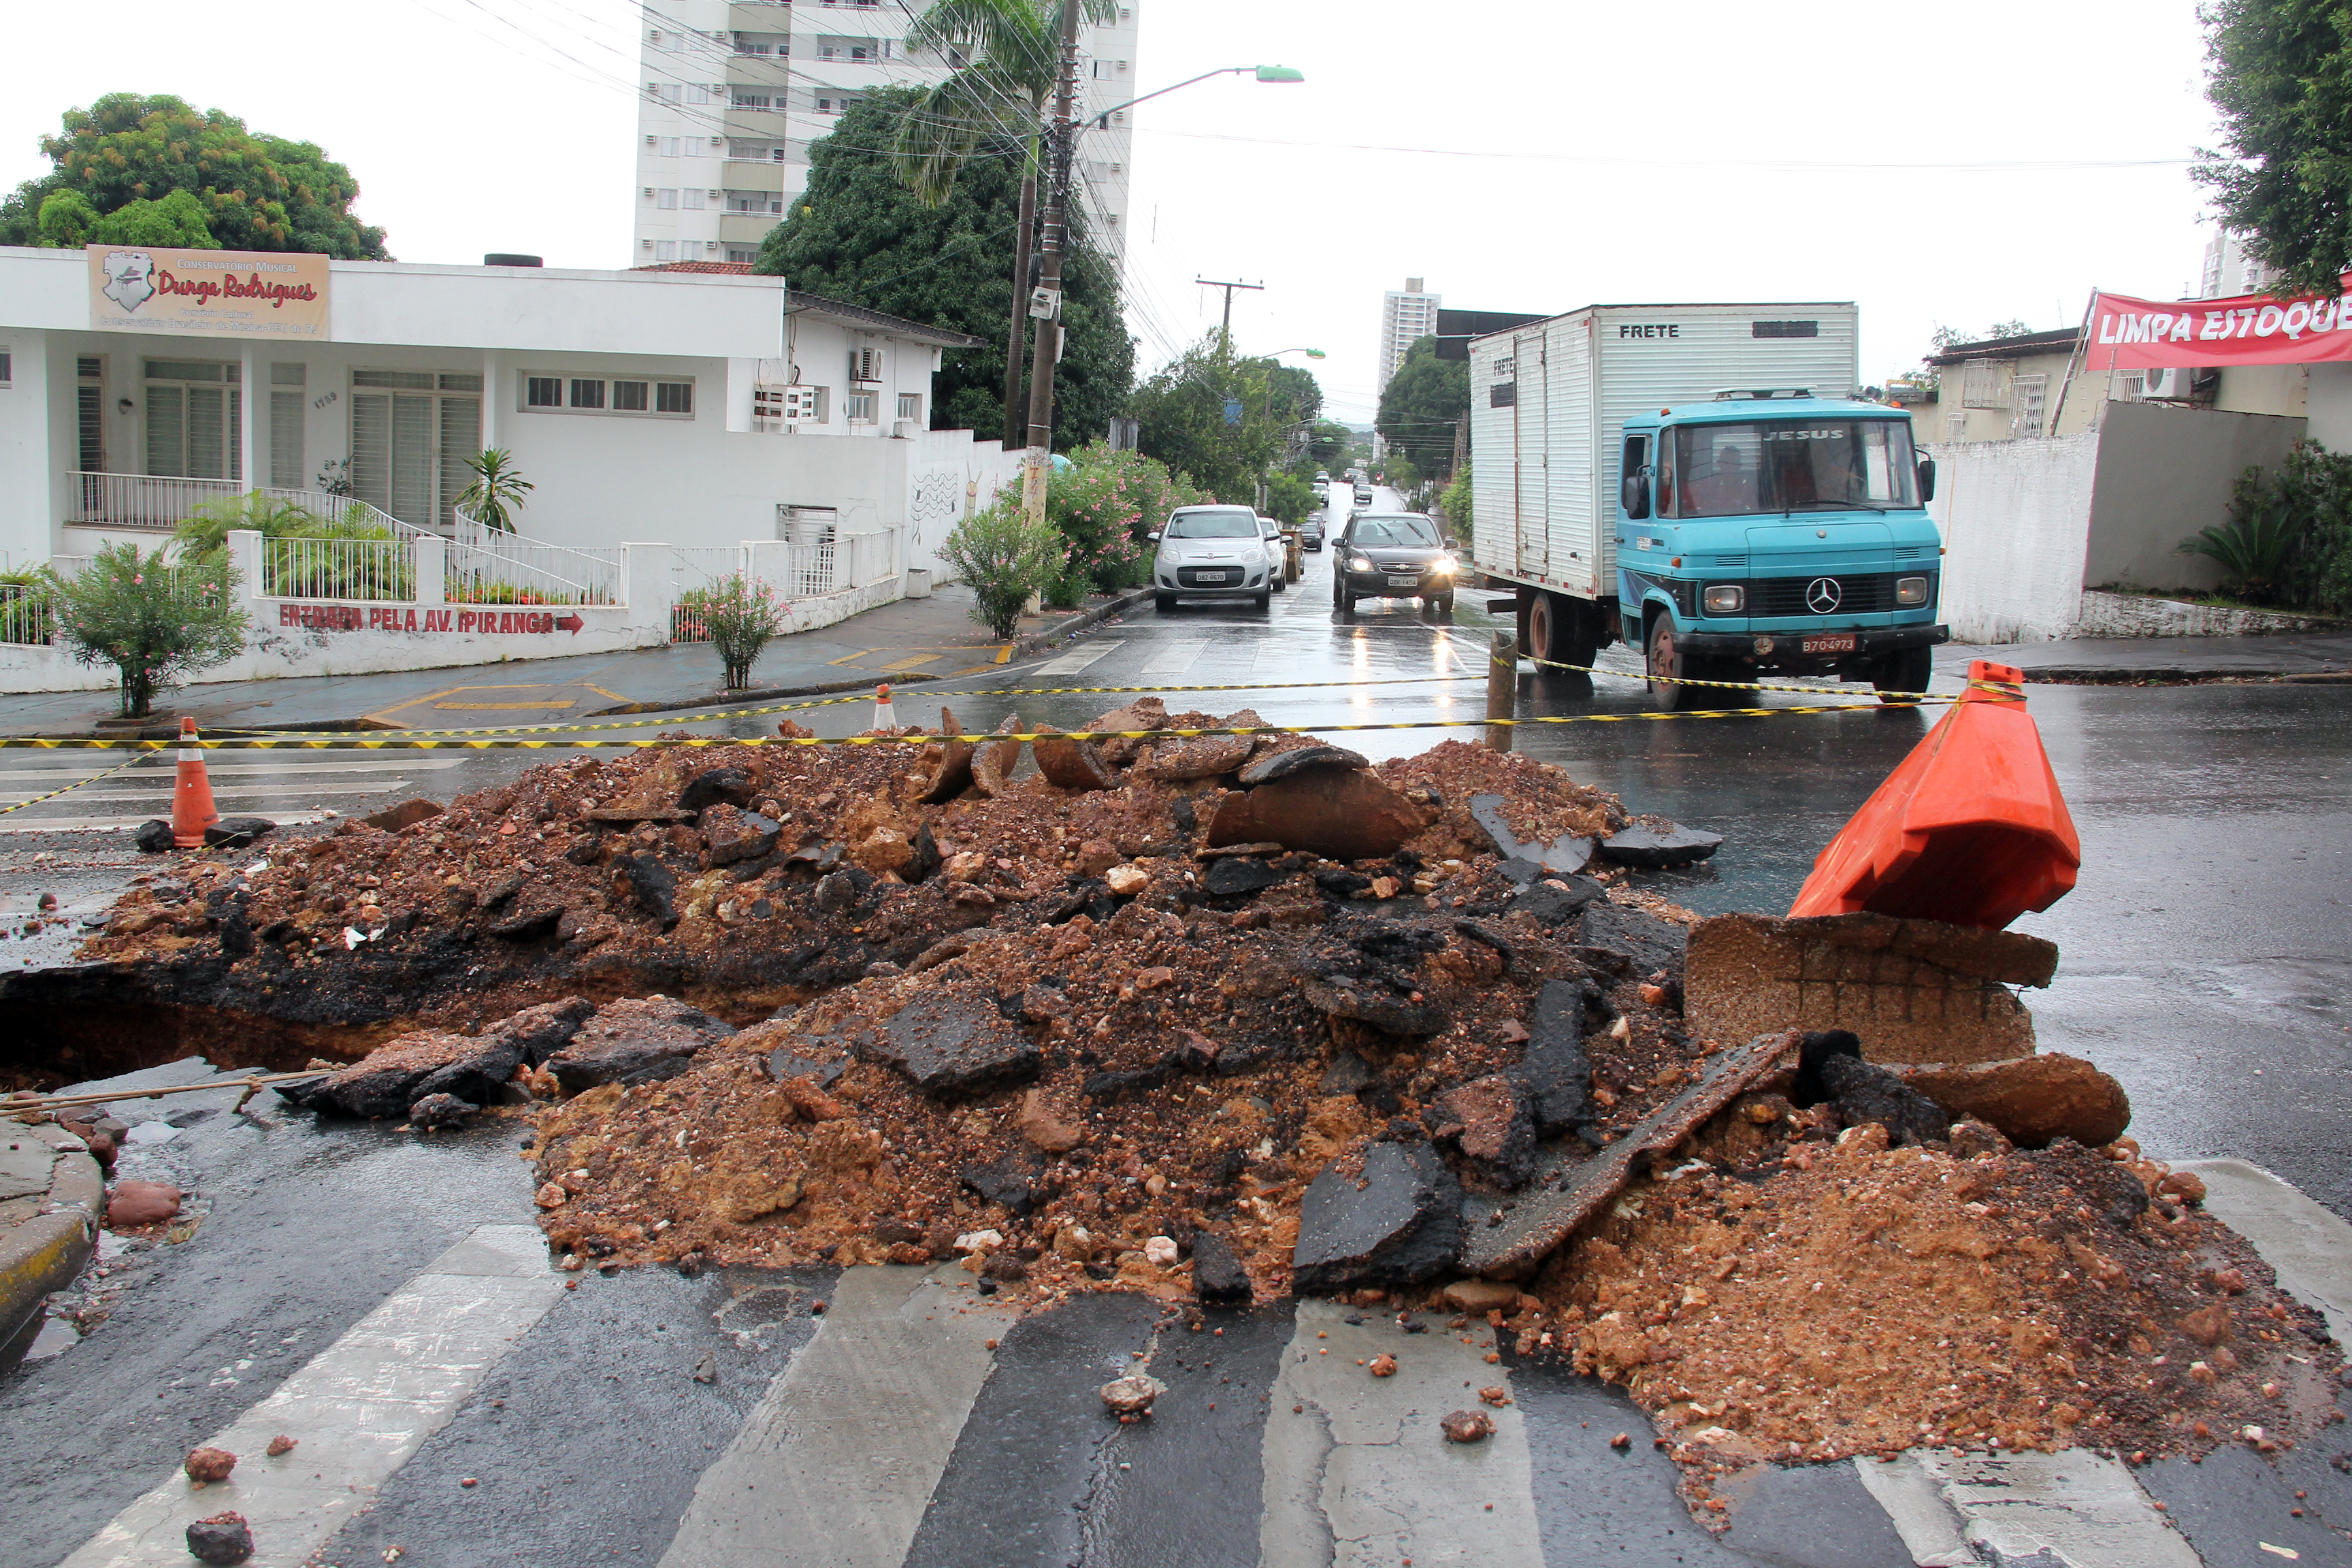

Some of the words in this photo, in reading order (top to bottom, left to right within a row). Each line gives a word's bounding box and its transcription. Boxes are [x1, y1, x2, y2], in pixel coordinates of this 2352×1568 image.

[256, 261, 298, 273] MUSICAL
[159, 270, 222, 305] Dunga
[224, 272, 318, 308] Rodrigues
[180, 308, 219, 317] Convênio
[221, 310, 254, 318] Cultural
[100, 315, 166, 327] Conservatório
[169, 318, 214, 329] Brasileiro
[216, 321, 228, 330] de
[291, 324, 303, 333] do
[306, 324, 318, 333] RJ
[1620, 325, 1680, 338] FRETE
[2098, 313, 2192, 344] LIMPA
[1494, 357, 1514, 376] FRETE
[1763, 430, 1843, 441] JESUS
[280, 604, 363, 630] ENTRADA
[370, 608, 418, 631] PELA
[424, 610, 453, 632] AV.
[458, 611, 553, 634] IPIRANGA
